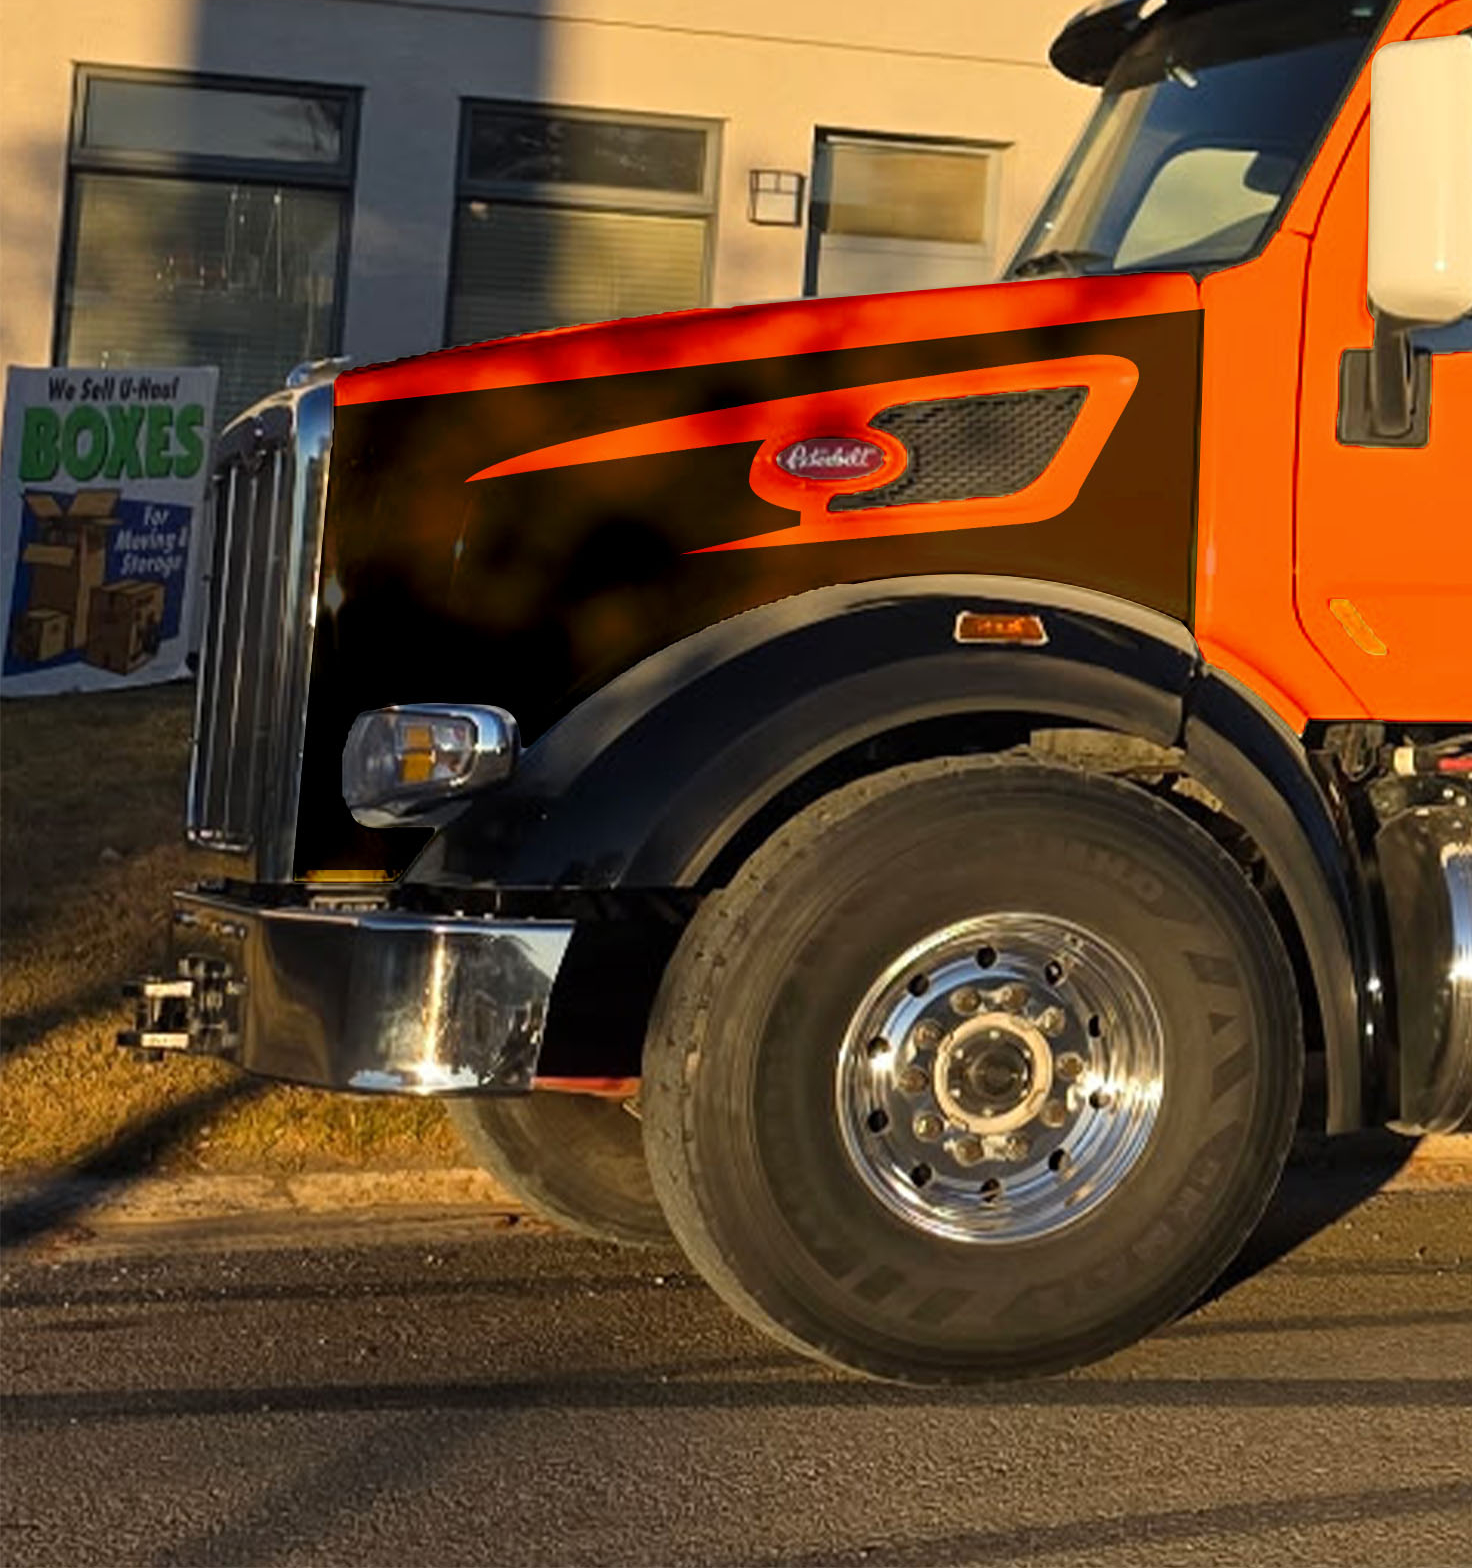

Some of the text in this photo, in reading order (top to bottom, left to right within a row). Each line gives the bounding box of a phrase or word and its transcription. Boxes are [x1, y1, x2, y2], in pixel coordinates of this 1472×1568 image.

[48, 377, 77, 402] We
[80, 376, 115, 401] Sell
[20, 405, 205, 482] BOXES
[142, 506, 169, 527] For
[113, 528, 176, 553] Moving
[120, 552, 184, 578] Storage
